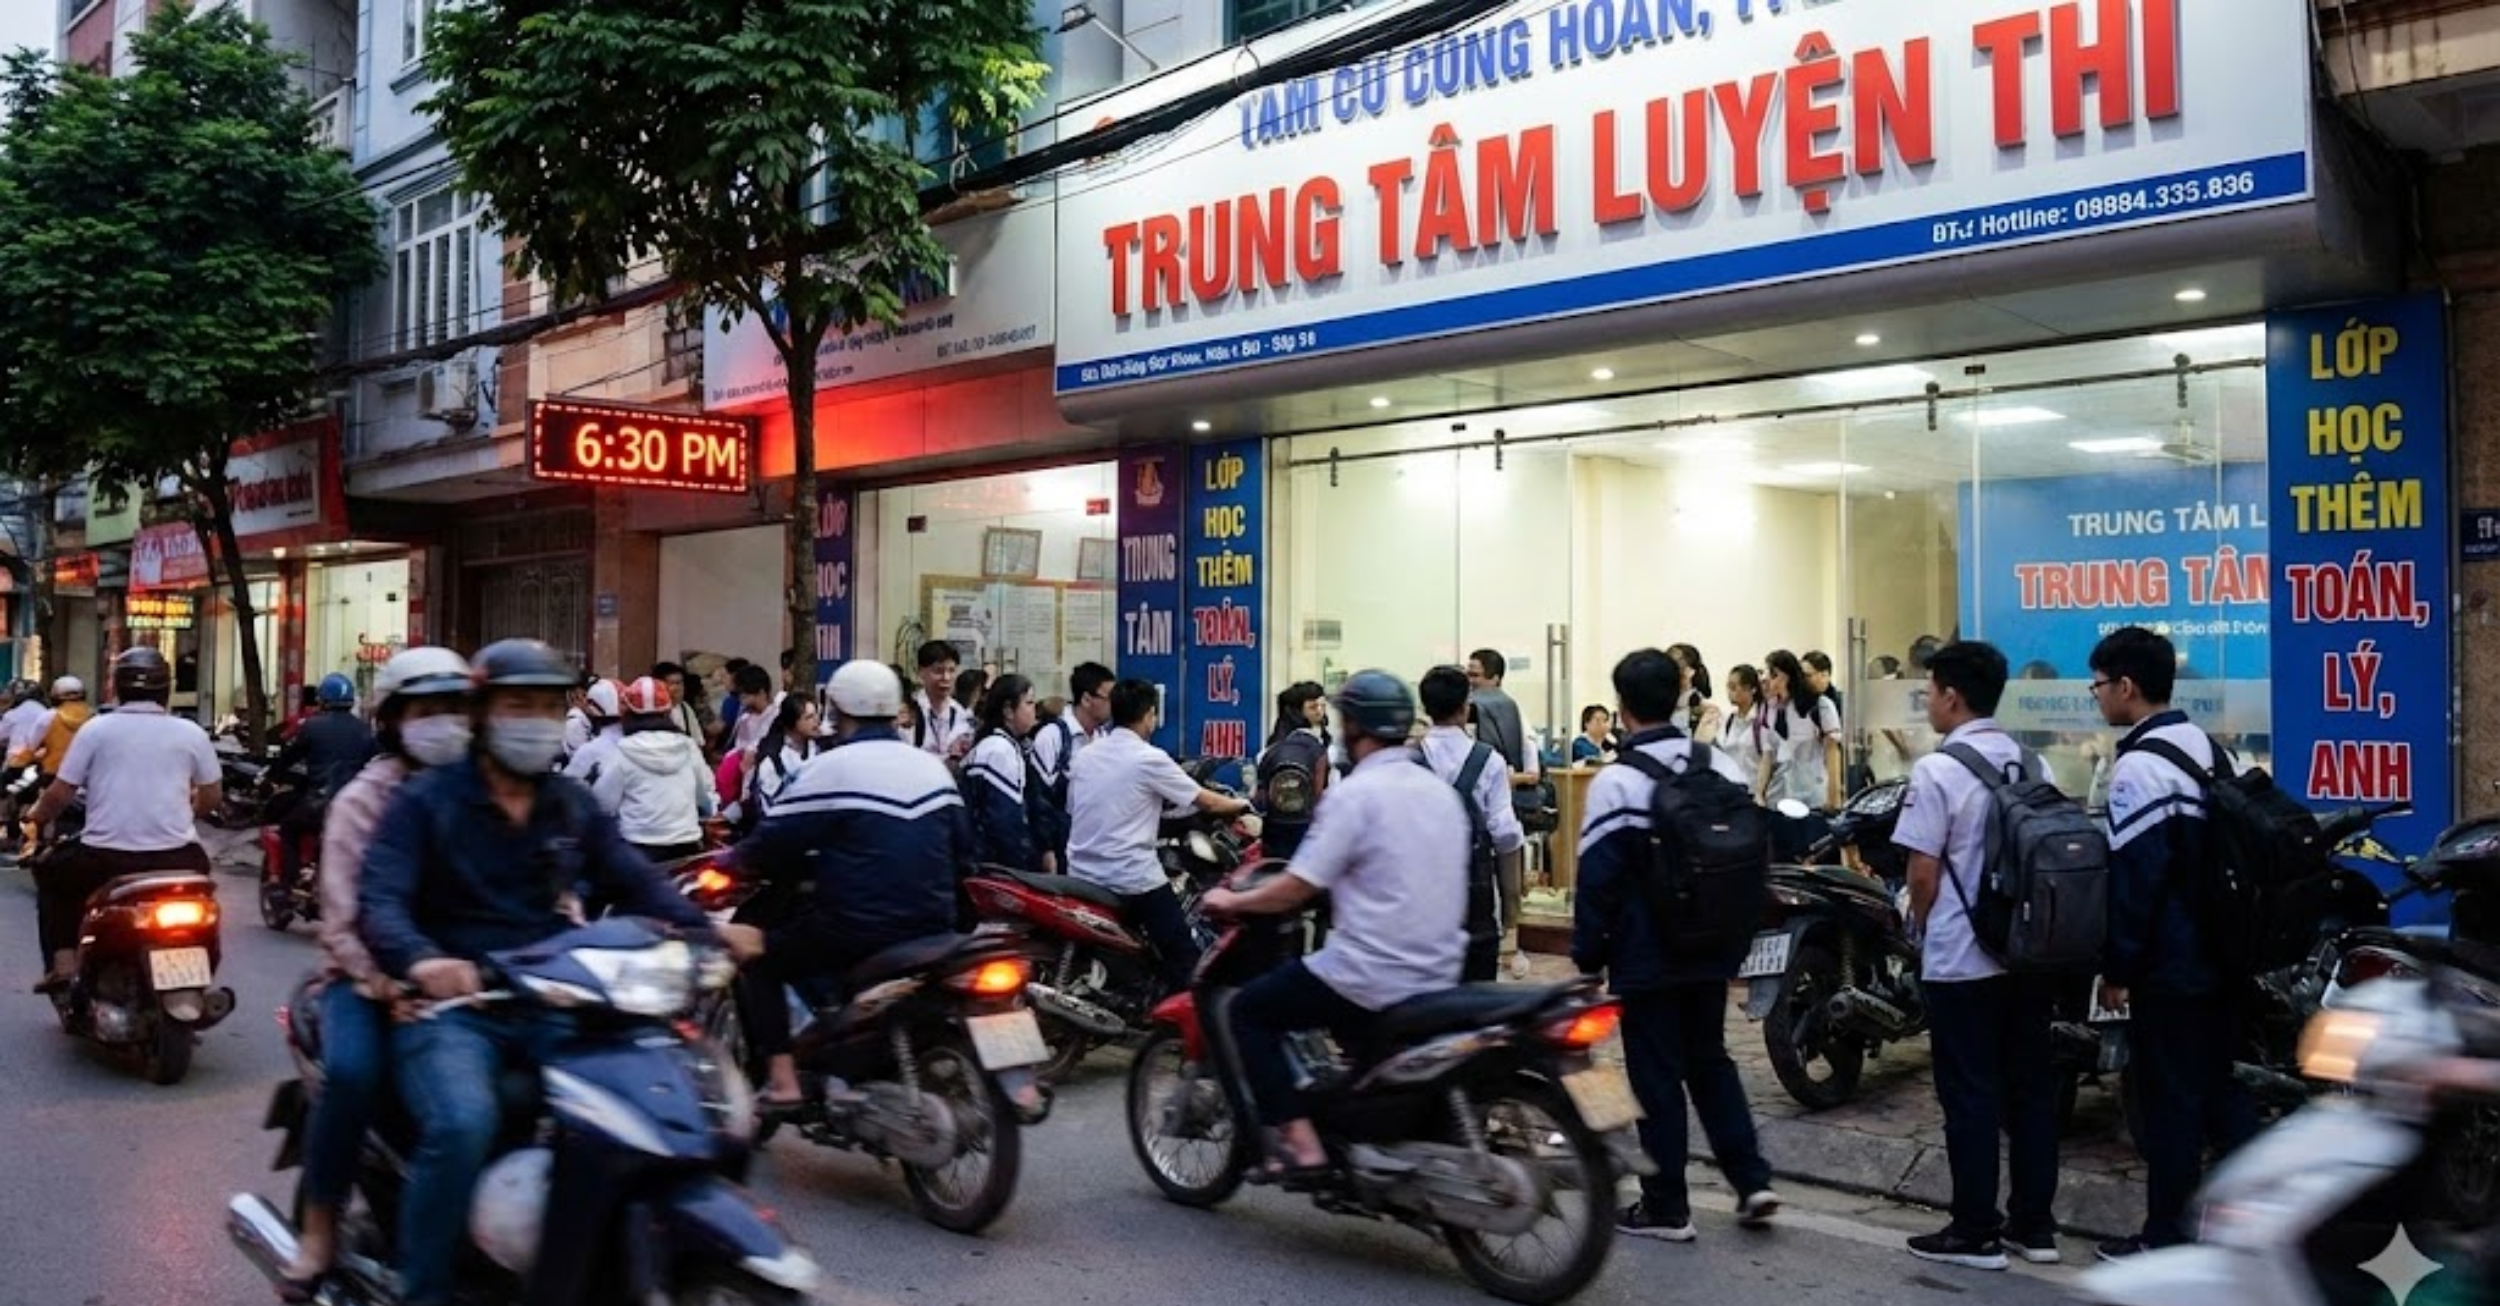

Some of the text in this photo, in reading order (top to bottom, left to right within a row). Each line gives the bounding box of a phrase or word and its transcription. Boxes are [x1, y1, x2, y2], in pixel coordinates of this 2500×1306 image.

[1103, 0, 2179, 316] TRUNG TÂM LUYỆN THI
[1981, 207, 2068, 236] Hotline:
[2311, 317, 2398, 380] LỚP
[576, 423, 737, 478] 6:30 PM
[2308, 403, 2403, 464] HỌC
[1205, 504, 1246, 547] HỌC
[2067, 510, 2166, 538] TRUNG
[2290, 471, 2422, 533] THÊM
[1123, 534, 1176, 582] TRUNG
[1196, 549, 1253, 588] THÊM
[2014, 557, 2170, 610] TRUNG
[2285, 549, 2430, 628] TOÁN,
[2323, 639, 2396, 719] LÝ,
[2307, 740, 2413, 801] ANH
